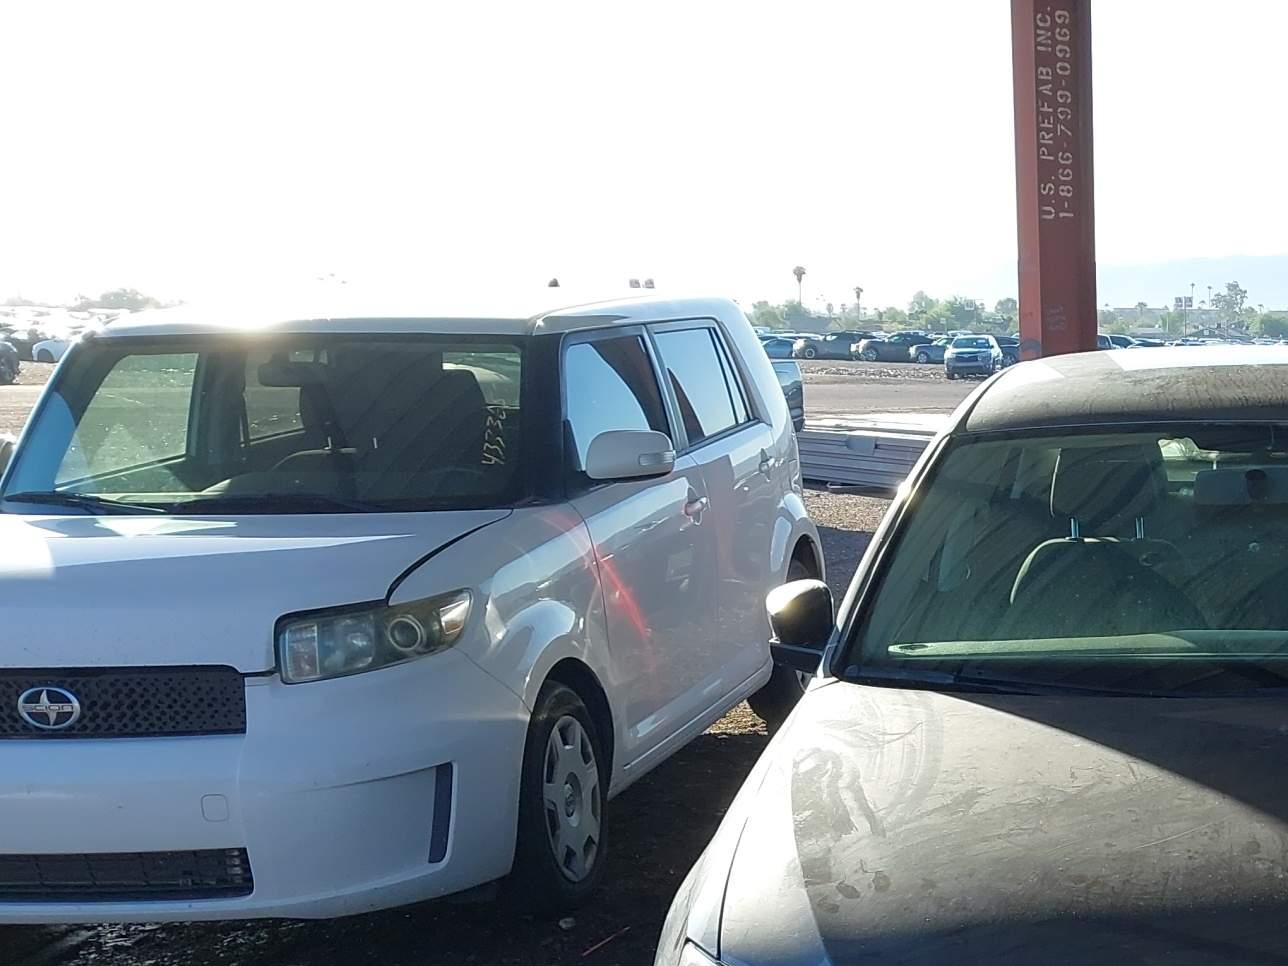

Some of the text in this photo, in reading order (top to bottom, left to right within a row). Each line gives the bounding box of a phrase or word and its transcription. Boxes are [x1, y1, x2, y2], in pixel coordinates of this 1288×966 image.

[1036, 6, 1056, 219] U.S. PREFAB INC.
[1055, 10, 1074, 218] 1-866-799-0969
